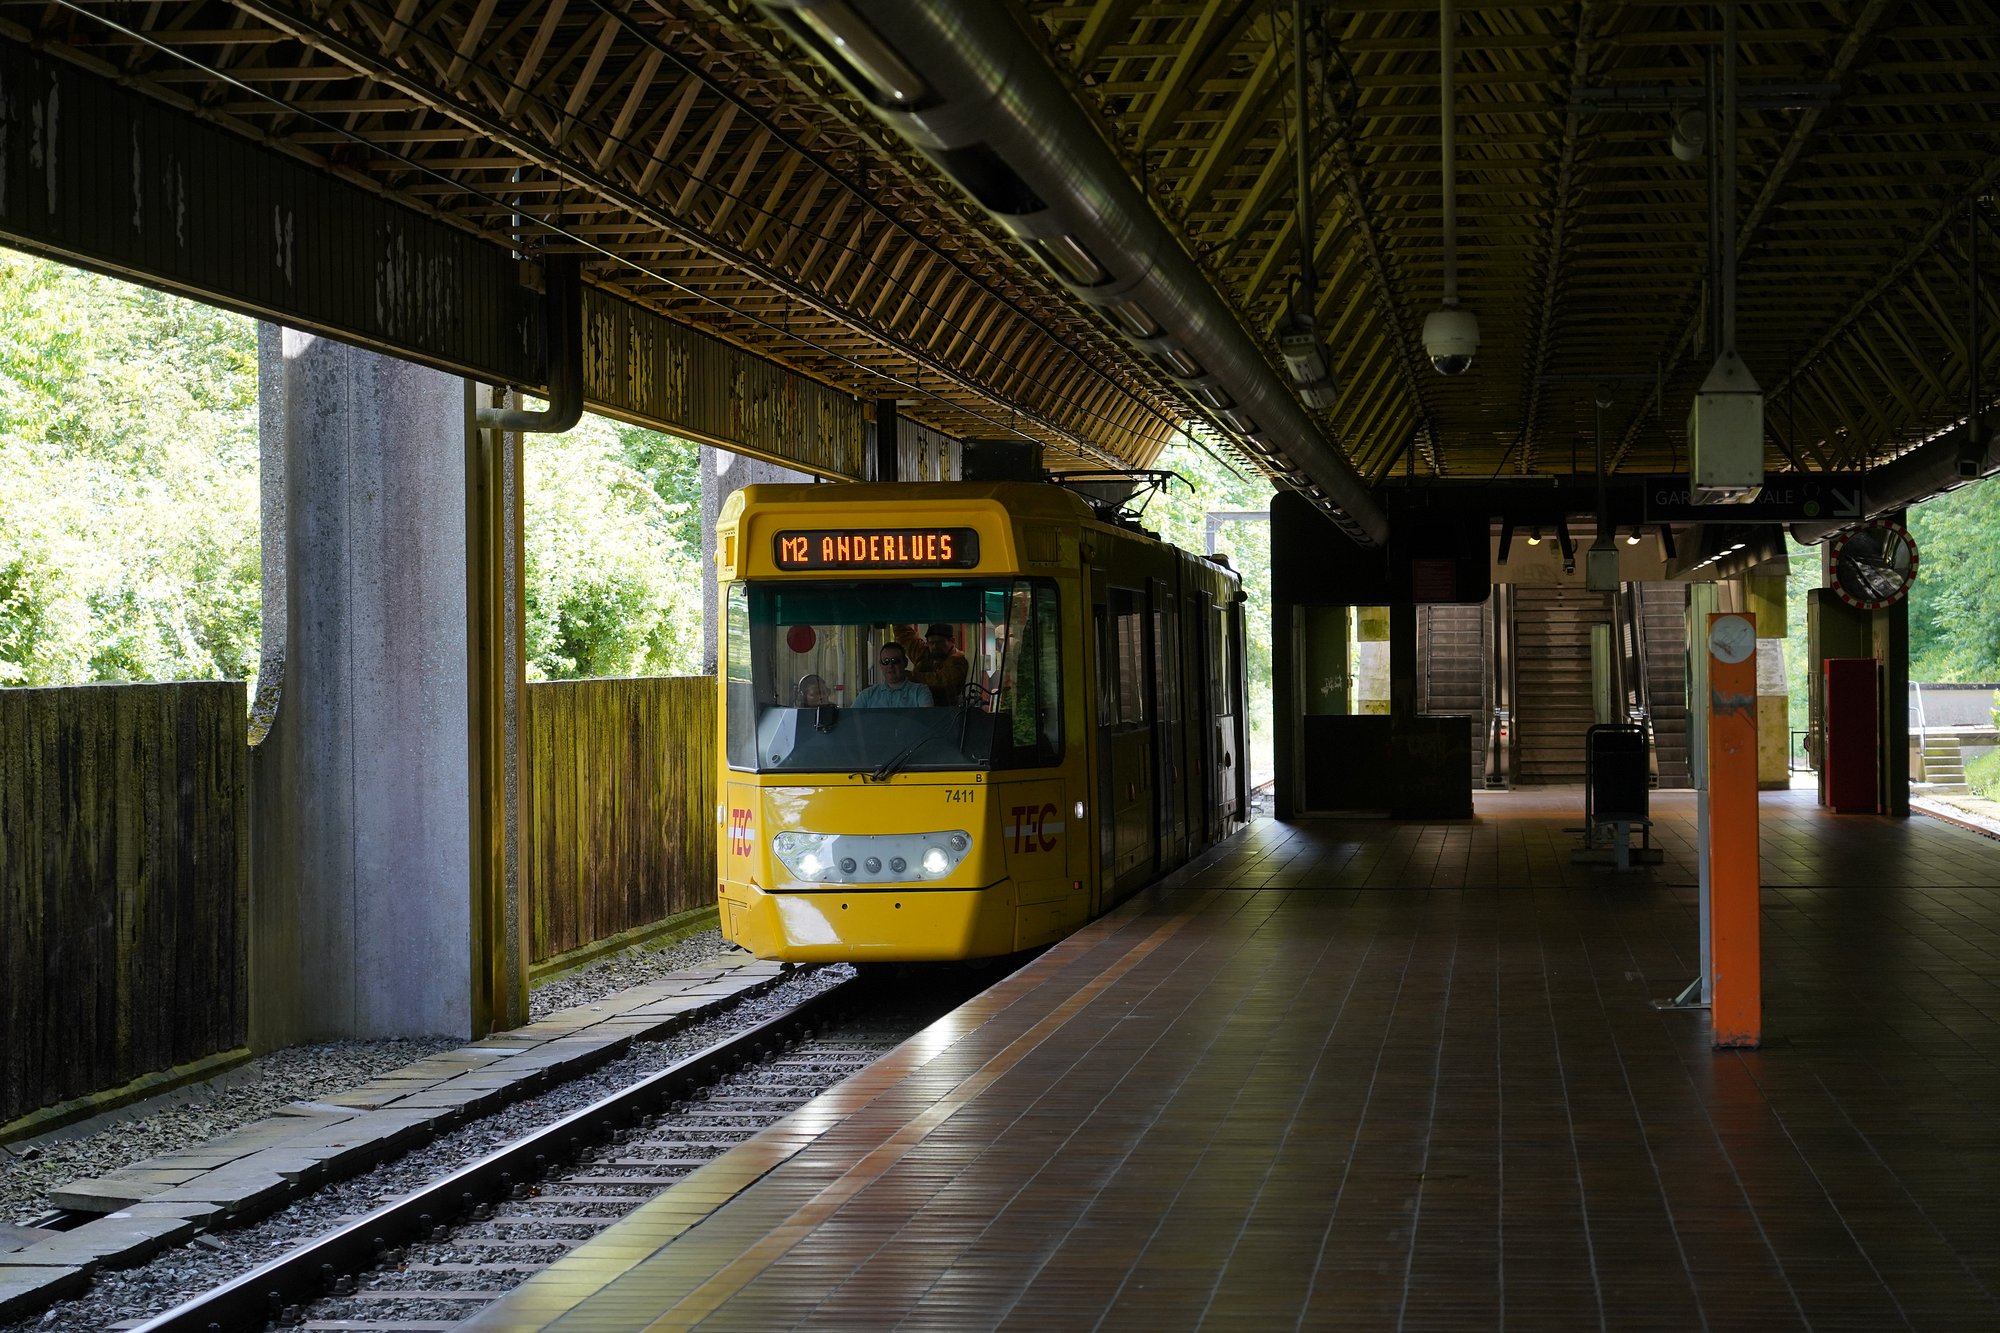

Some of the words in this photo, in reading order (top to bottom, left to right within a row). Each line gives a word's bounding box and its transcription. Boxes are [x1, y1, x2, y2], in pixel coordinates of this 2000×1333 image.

[1655, 490, 1691, 505] GAR
[782, 536, 809, 562] M2
[822, 535, 952, 562] ANDERLUES
[976, 774, 983, 783] B
[945, 790, 975, 803] 7411
[732, 808, 752, 858] TEC
[1011, 803, 1058, 854] TEC
